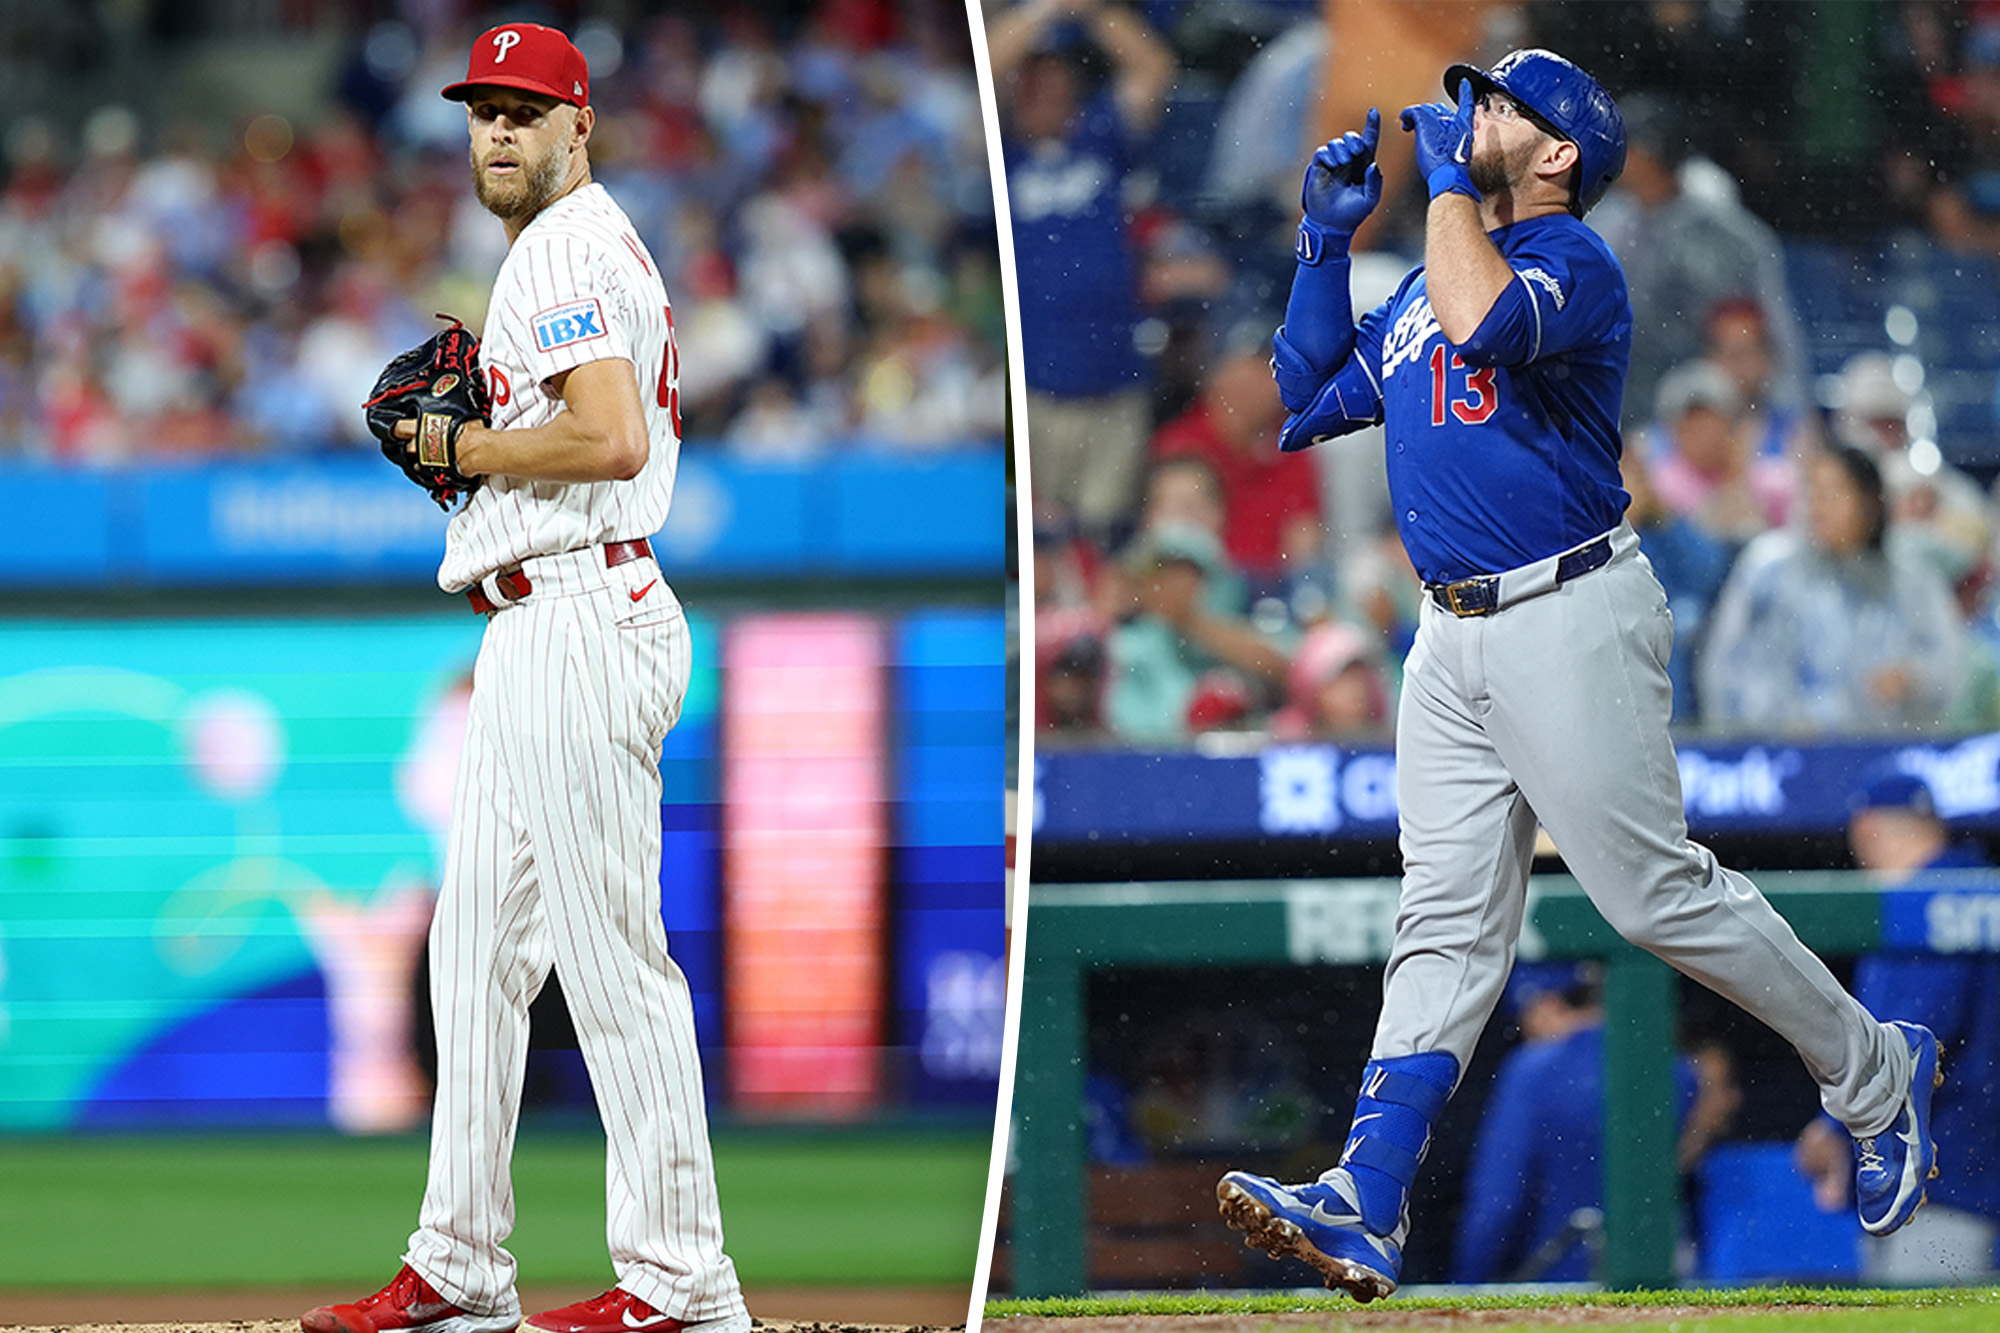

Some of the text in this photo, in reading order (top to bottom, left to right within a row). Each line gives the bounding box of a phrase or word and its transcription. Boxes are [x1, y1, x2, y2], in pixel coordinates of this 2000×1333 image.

[493, 30, 521, 63] P
[538, 310, 601, 347] IBX
[1430, 343, 1499, 427] 13
